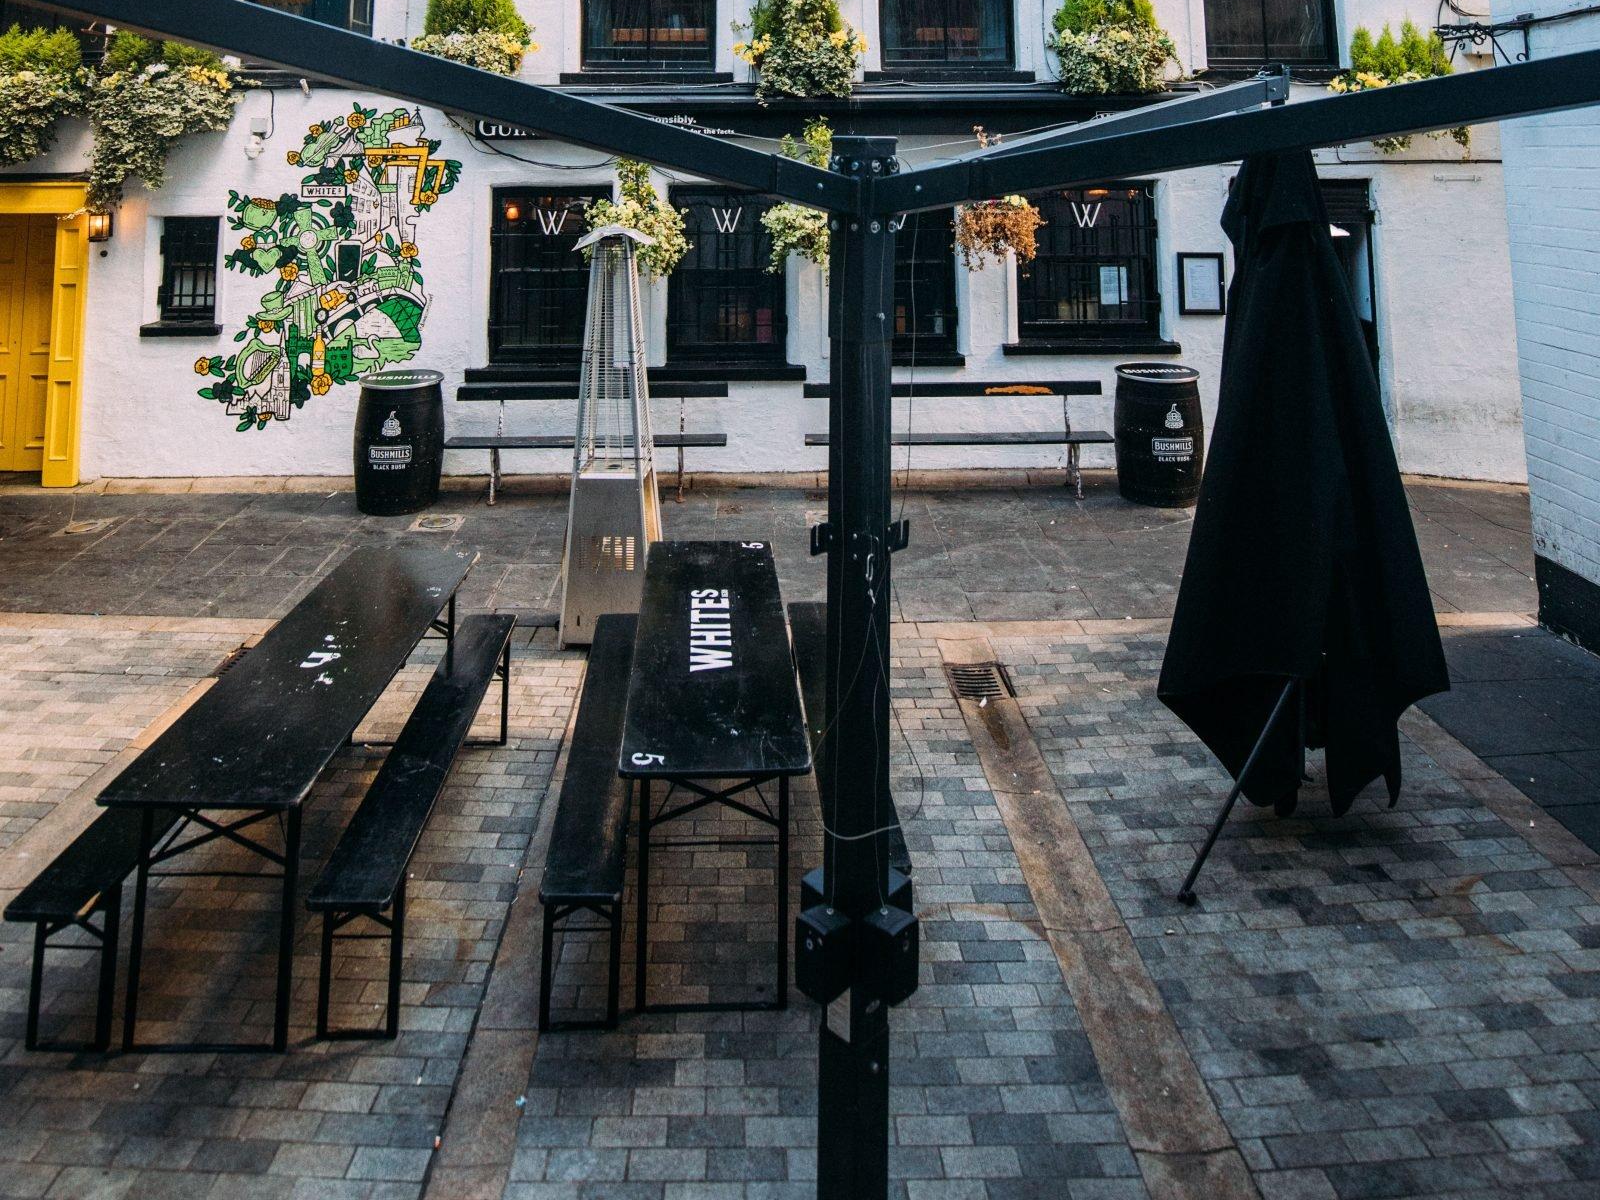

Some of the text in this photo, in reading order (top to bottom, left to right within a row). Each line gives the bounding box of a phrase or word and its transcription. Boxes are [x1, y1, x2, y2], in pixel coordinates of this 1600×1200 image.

[306, 186, 342, 196] WHITES
[537, 208, 568, 235] W
[711, 206, 742, 233] W
[1071, 202, 1102, 228] W
[370, 449, 410, 459] BUSHMILLS
[1154, 441, 1192, 451] BUSHMILLS
[689, 588, 733, 673] WHITES
[631, 752, 665, 766] 5
